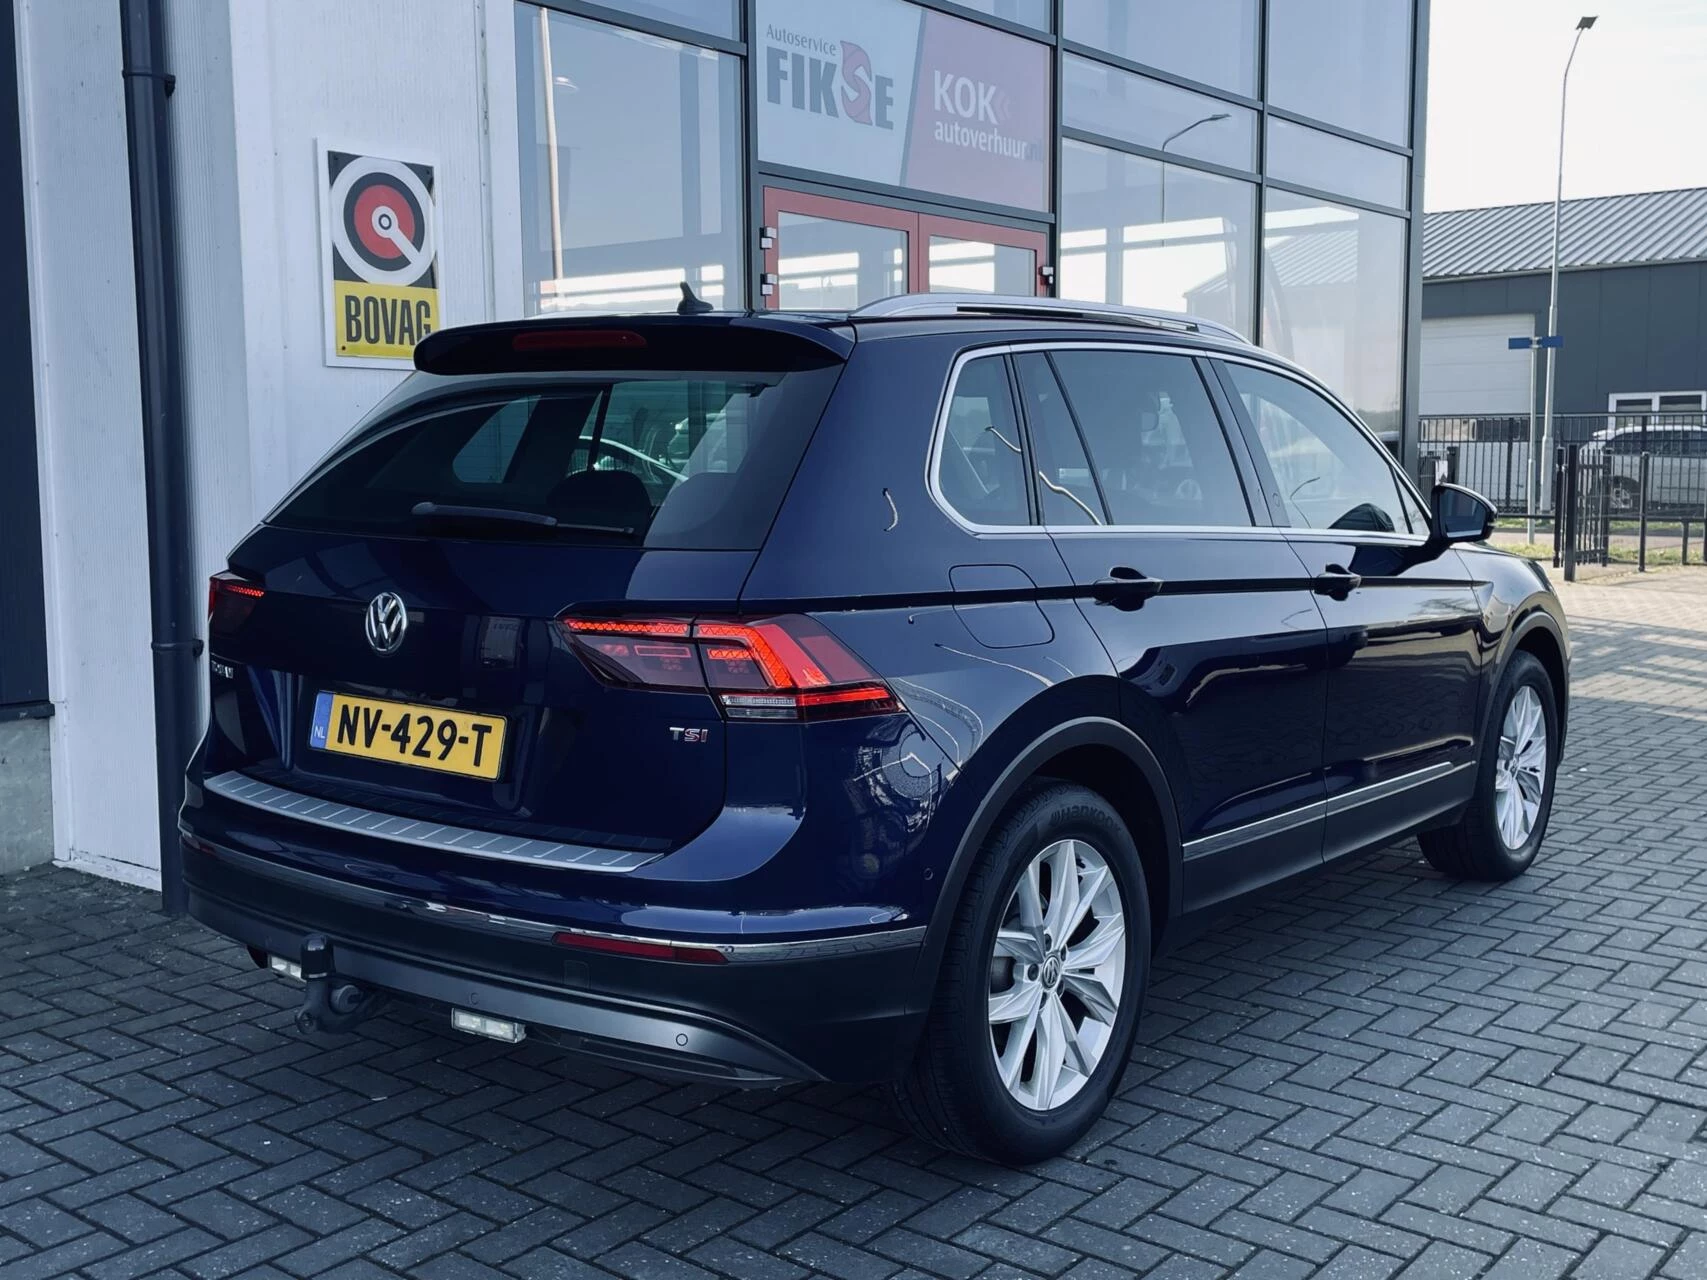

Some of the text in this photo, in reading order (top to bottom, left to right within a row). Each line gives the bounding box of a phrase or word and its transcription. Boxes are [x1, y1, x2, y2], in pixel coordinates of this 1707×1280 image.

[767, 24, 837, 56] Autoservice
[766, 40, 894, 130] FIKSE
[934, 69, 1000, 125] KOK
[345, 295, 431, 346] BOVAG
[313, 726, 326, 740] NL
[337, 704, 492, 767] NV-429-T
[669, 726, 708, 742] TSI
